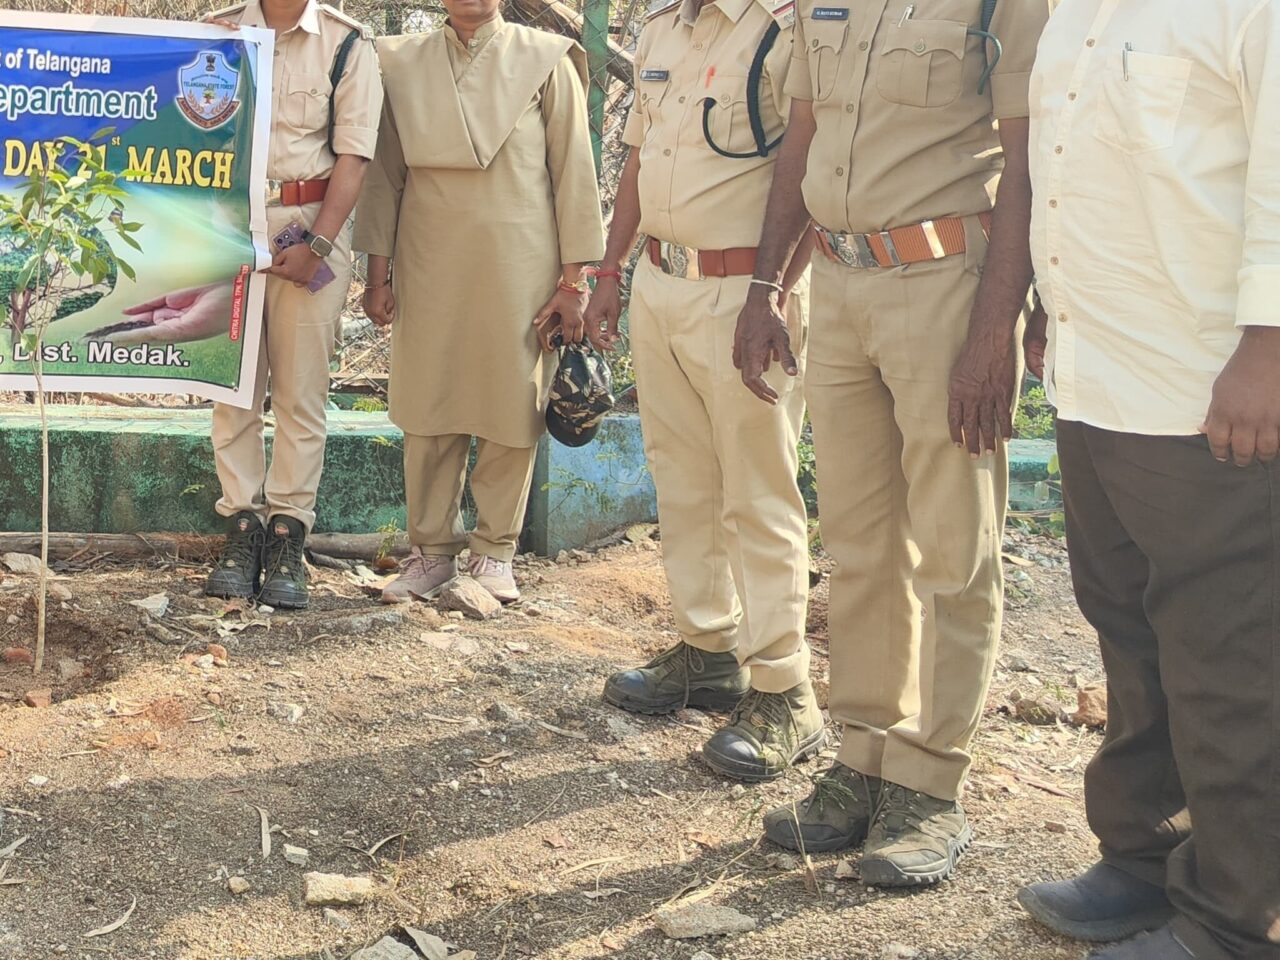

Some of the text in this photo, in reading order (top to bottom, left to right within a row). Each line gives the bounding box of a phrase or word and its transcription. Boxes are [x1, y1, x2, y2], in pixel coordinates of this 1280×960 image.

[5, 48, 23, 69] of
[27, 49, 111, 76] Telangana
[126, 146, 234, 188] MARCH
[231, 318, 239, 340] CHITRA
[87, 341, 191, 367] Medak.
